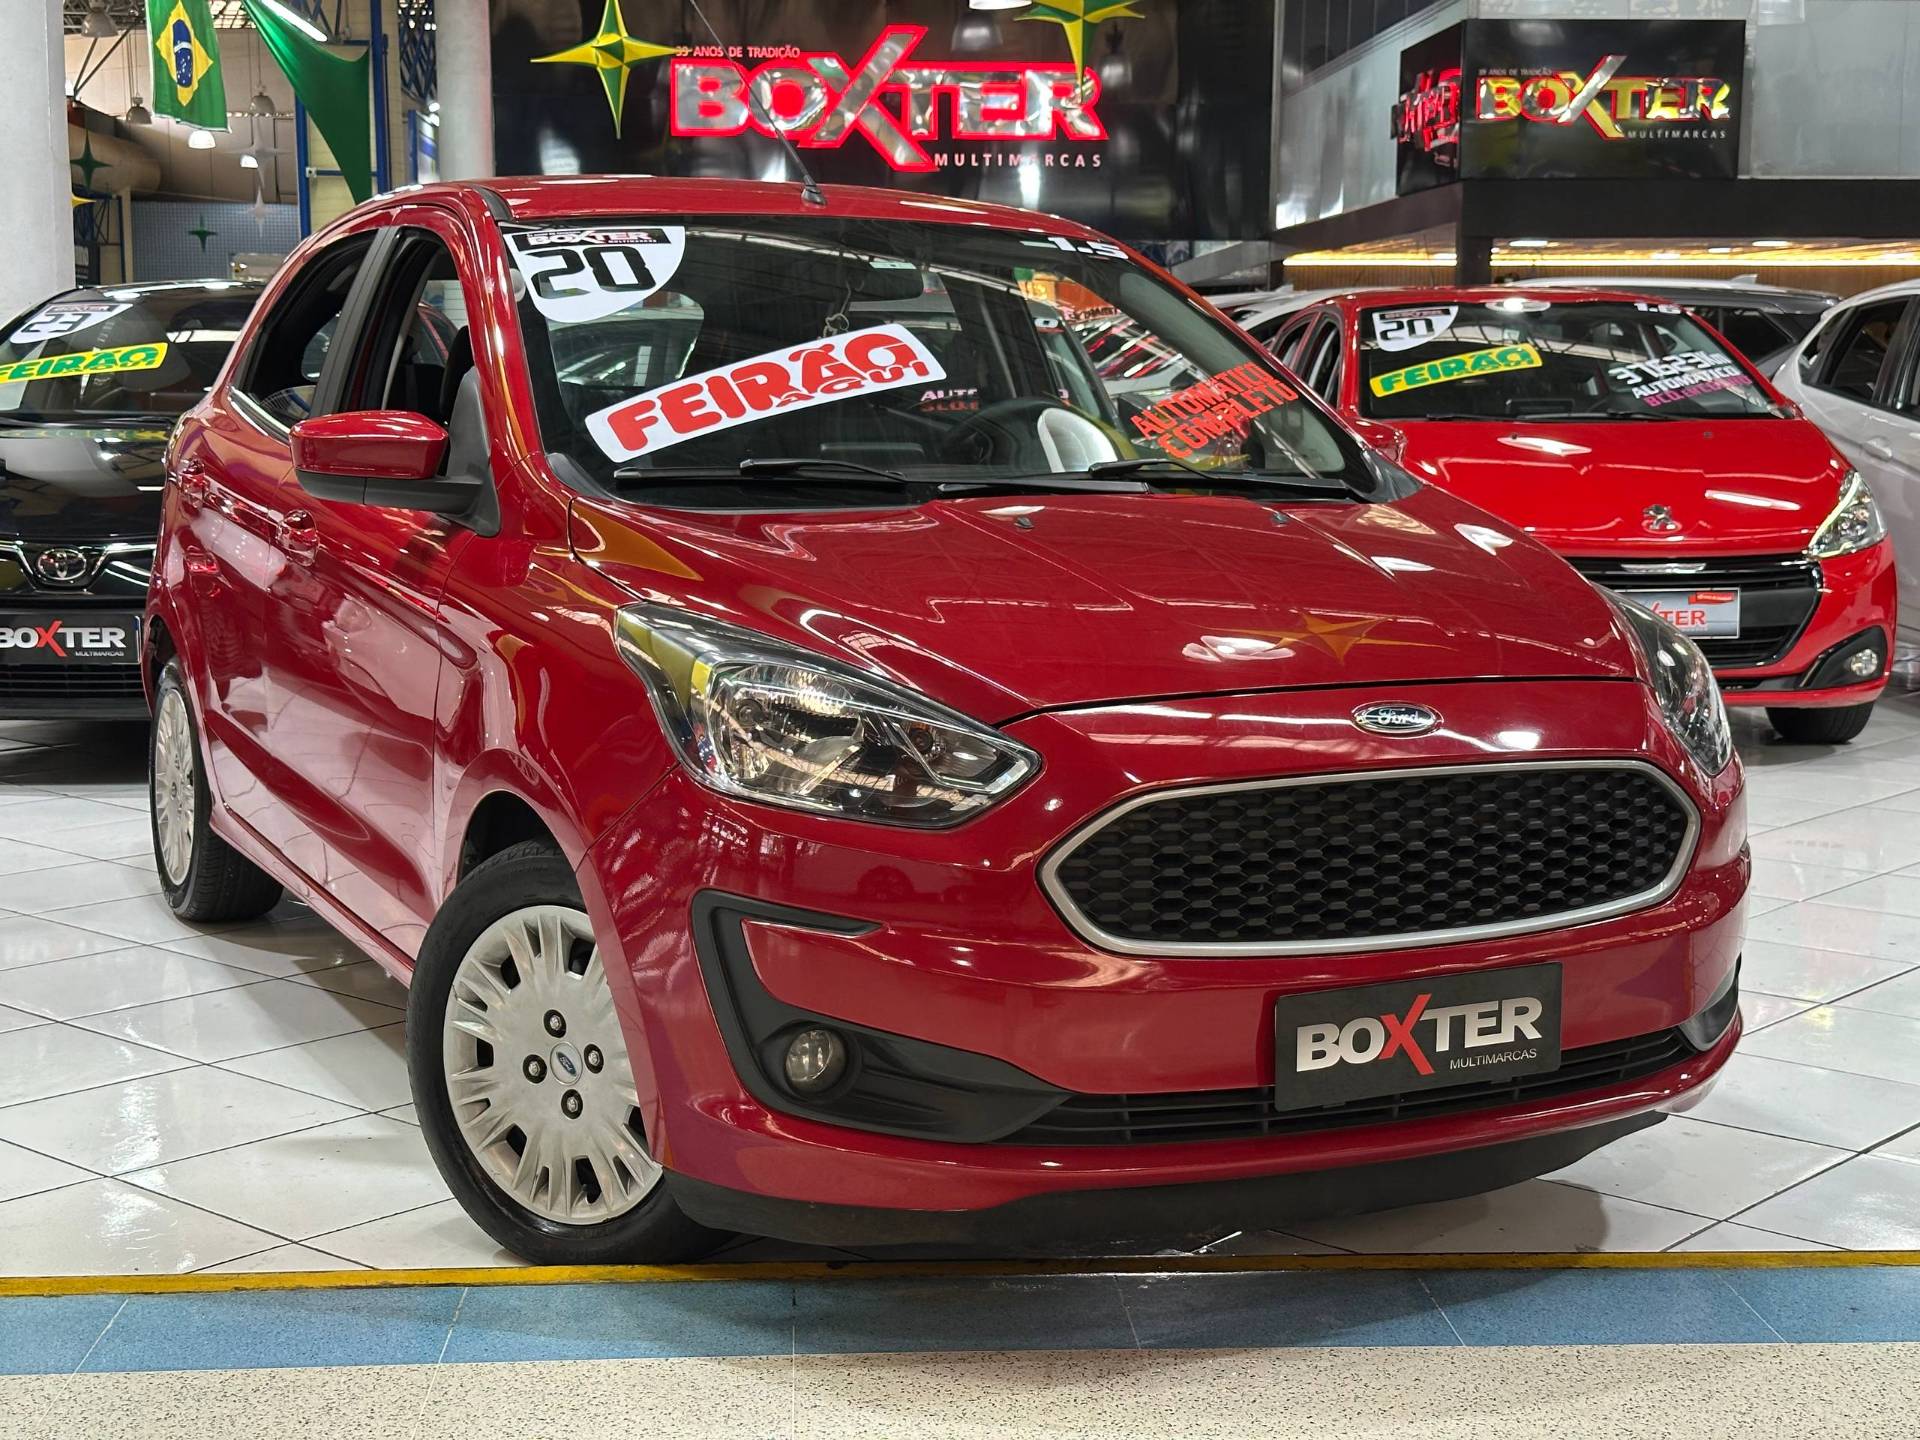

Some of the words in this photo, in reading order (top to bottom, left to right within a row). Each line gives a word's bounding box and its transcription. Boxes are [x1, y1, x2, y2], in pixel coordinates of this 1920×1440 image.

[693, 46, 723, 57] ANOS
[728, 46, 743, 57] DE
[747, 44, 801, 60] TRADIÇÃO
[670, 25, 1109, 172] BOXTER
[1476, 55, 1731, 140] BOXTER
[1627, 130, 1727, 139] MULTIMARCAS
[934, 152, 1102, 167] MULTIMARCAS
[527, 230, 652, 246] BOXTER
[1047, 236, 1129, 260] 1.5
[525, 245, 657, 300] 20
[1380, 318, 1435, 341] 20
[607, 333, 919, 451] FEIRÃO
[776, 361, 930, 408] AQUI
[0, 620, 127, 657] BOXTER
[1378, 707, 1420, 725] Ford
[1296, 993, 1543, 1076] BOXTER
[1449, 1047, 1538, 1071] MULTIMARCAS
